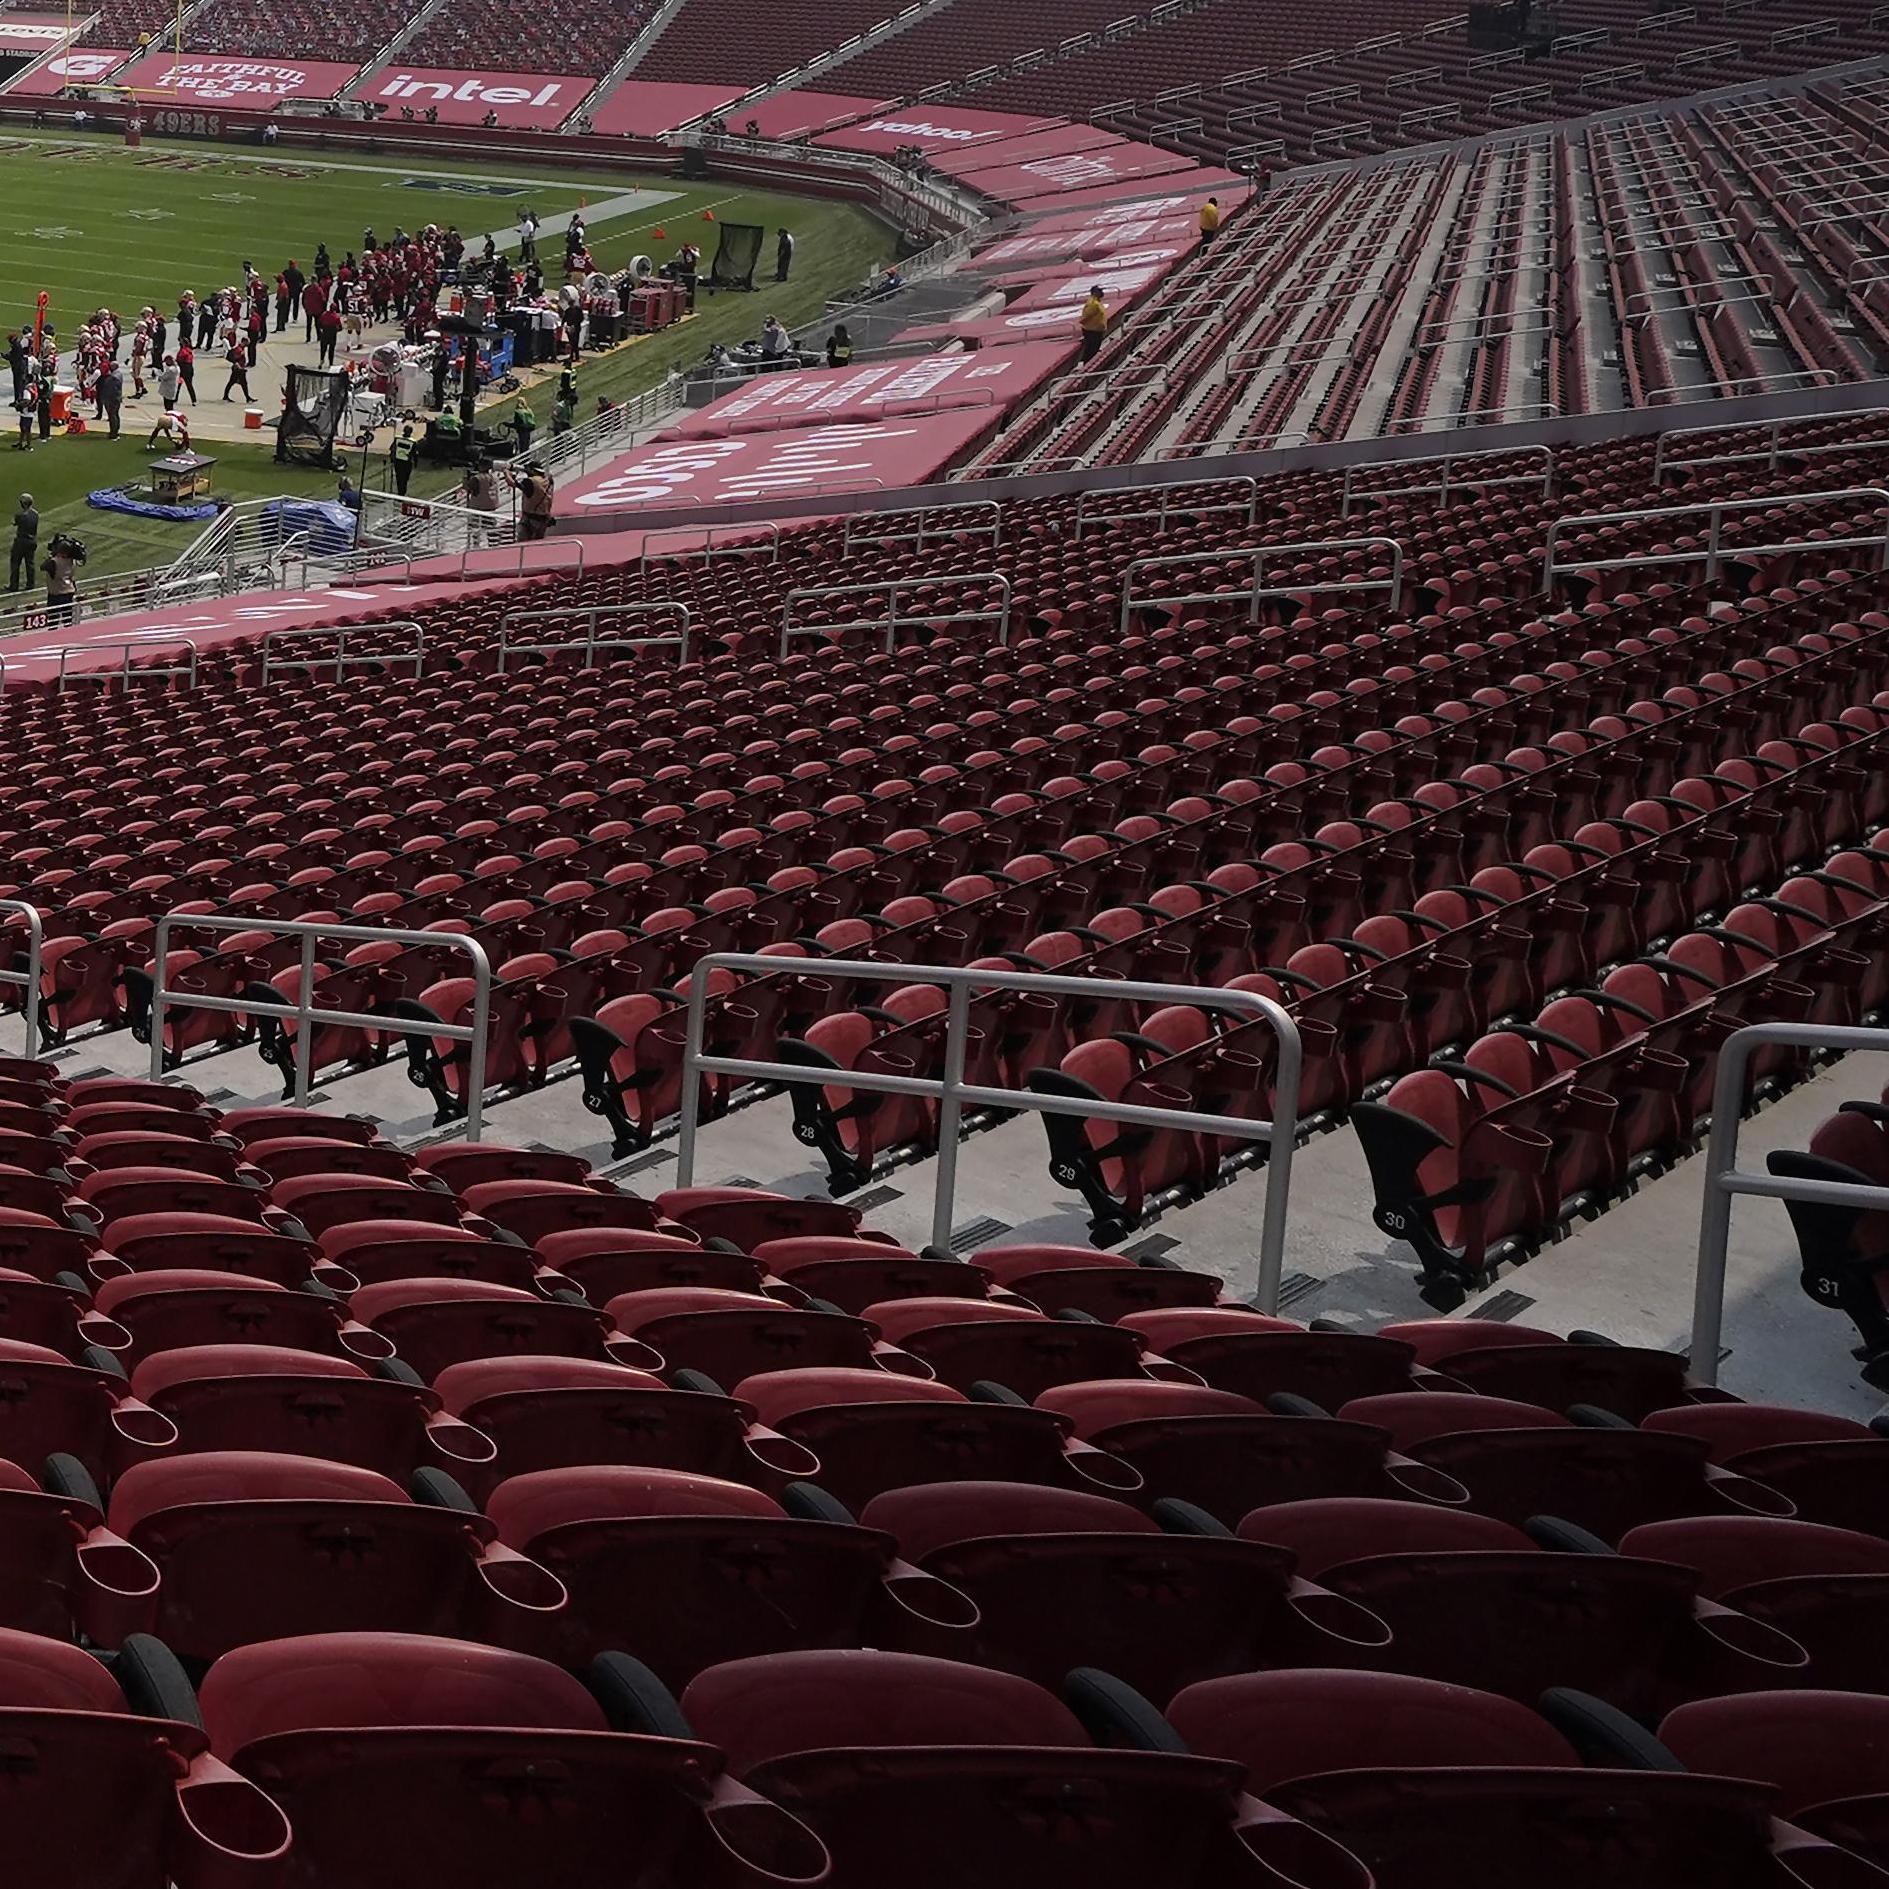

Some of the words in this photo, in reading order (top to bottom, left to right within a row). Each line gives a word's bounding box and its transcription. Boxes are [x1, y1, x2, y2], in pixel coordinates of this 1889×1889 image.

[167, 63, 307, 85] FAITHFUL
[380, 75, 564, 107] intel
[153, 111, 219, 135] 49ERS
[26, 614, 48, 628] 143
[800, 1124, 815, 1140] 28
[1058, 1165, 1076, 1181] 29
[1385, 1211, 1405, 1230] 30
[1818, 1277, 1838, 1297] 31
